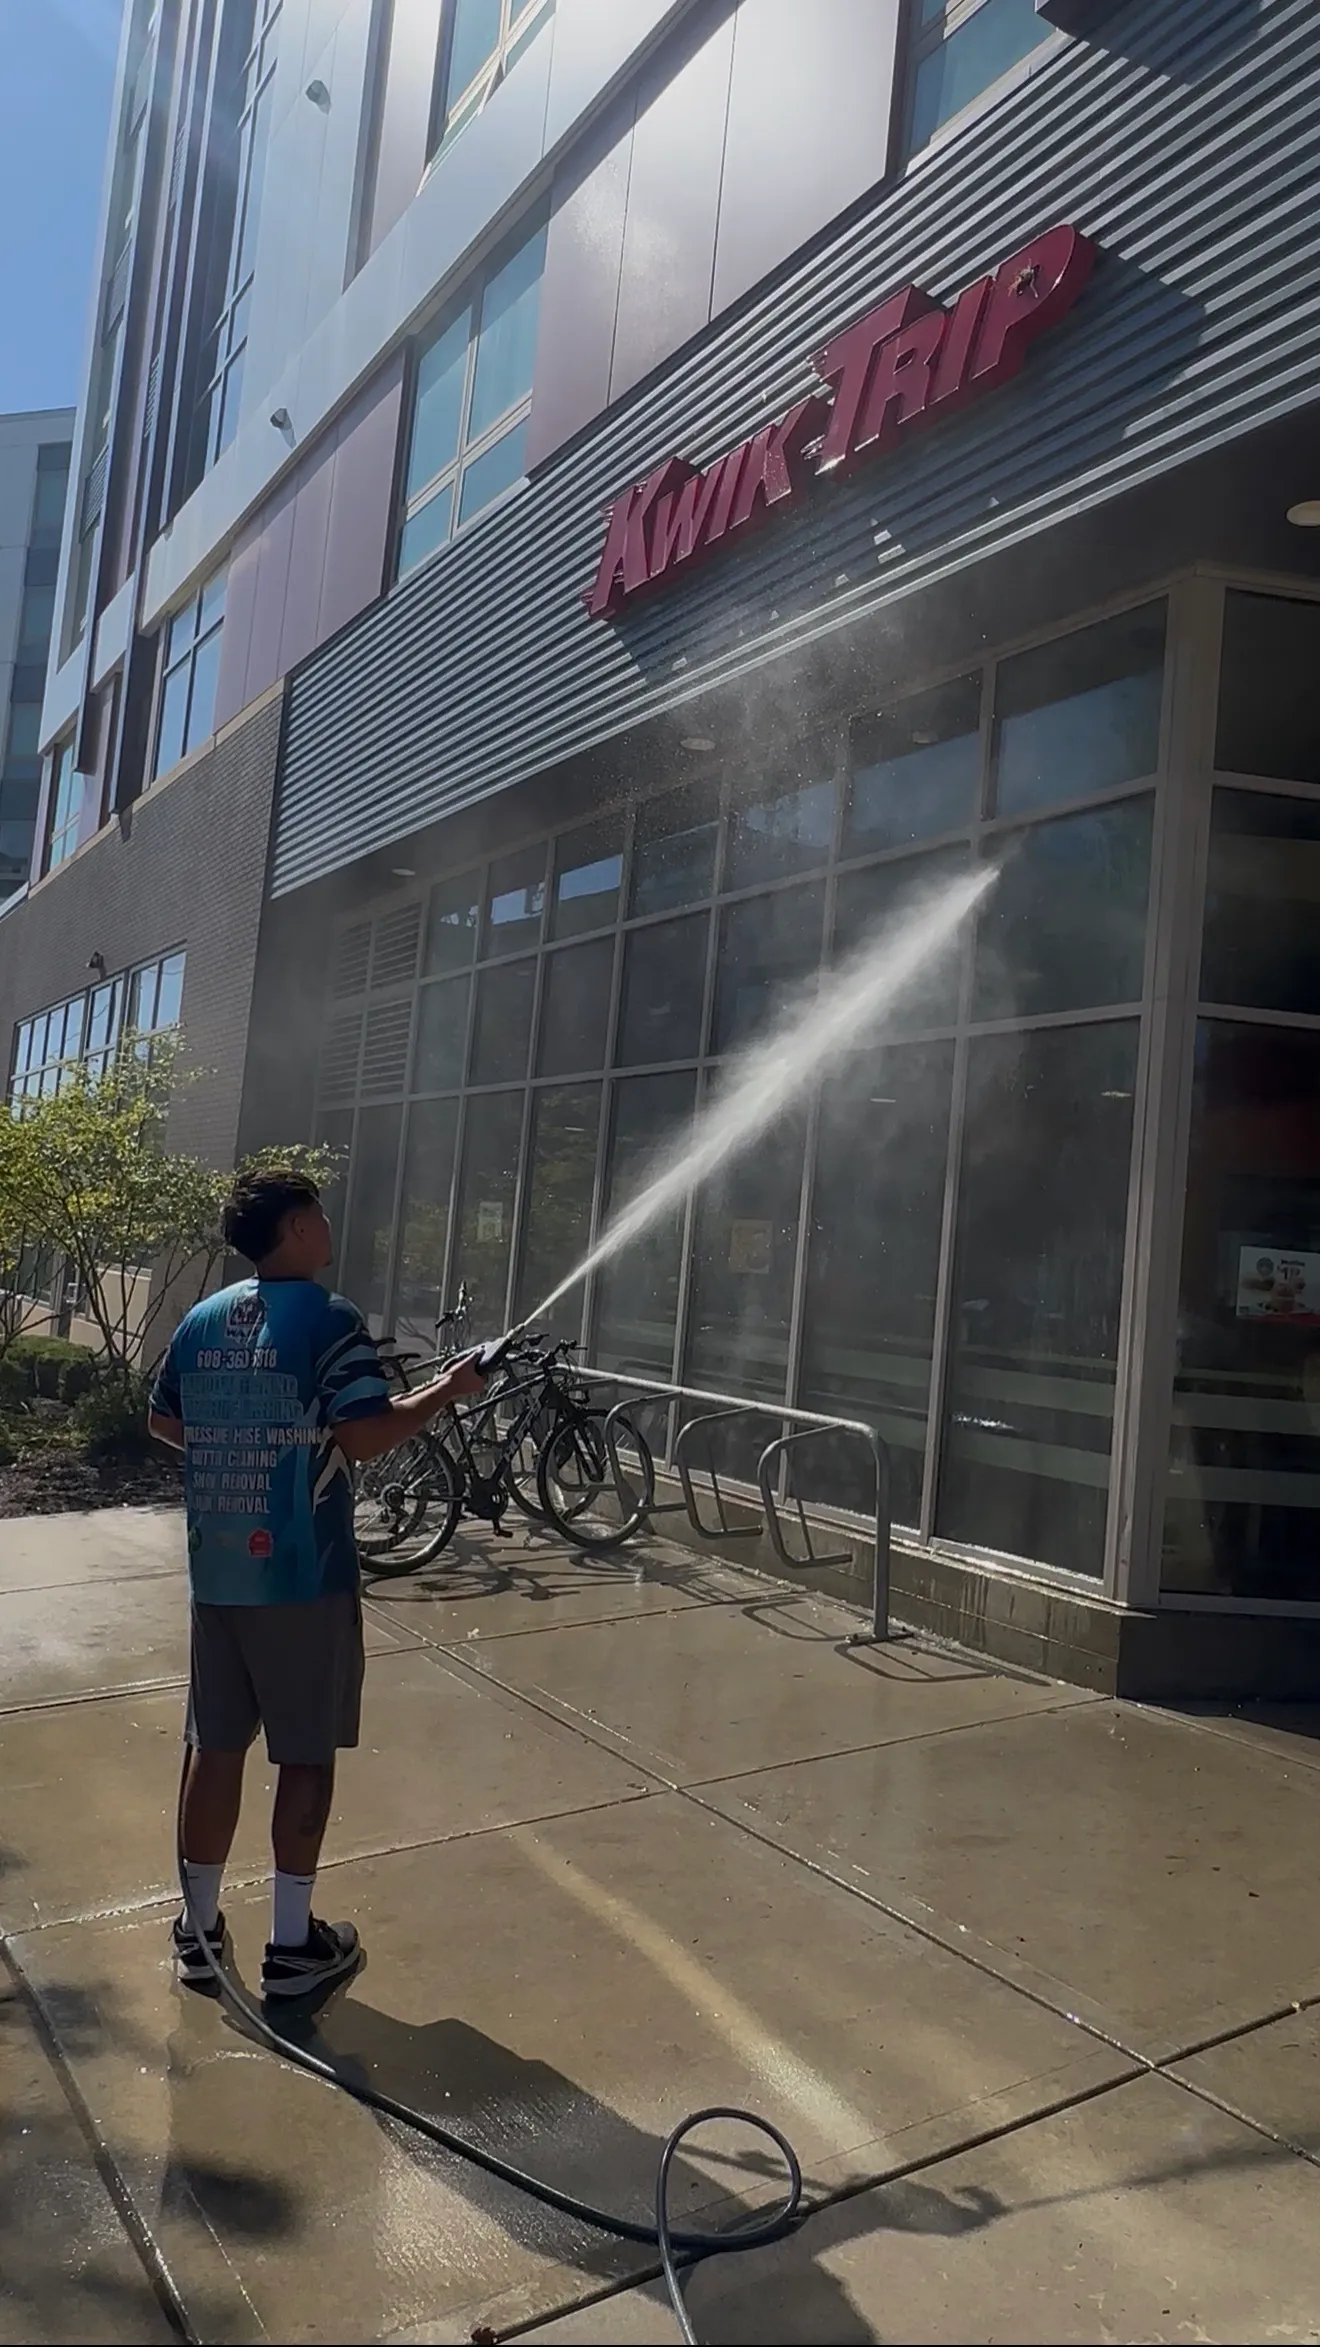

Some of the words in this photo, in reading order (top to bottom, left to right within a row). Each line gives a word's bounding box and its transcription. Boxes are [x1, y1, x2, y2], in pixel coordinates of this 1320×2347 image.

[583, 397, 826, 619] KWIK
[803, 224, 1092, 475] TRIP
[184, 1426, 228, 1444] PRESSUE
[227, 1449, 278, 1468] CLANING
[218, 1495, 271, 1514] REOVAL
